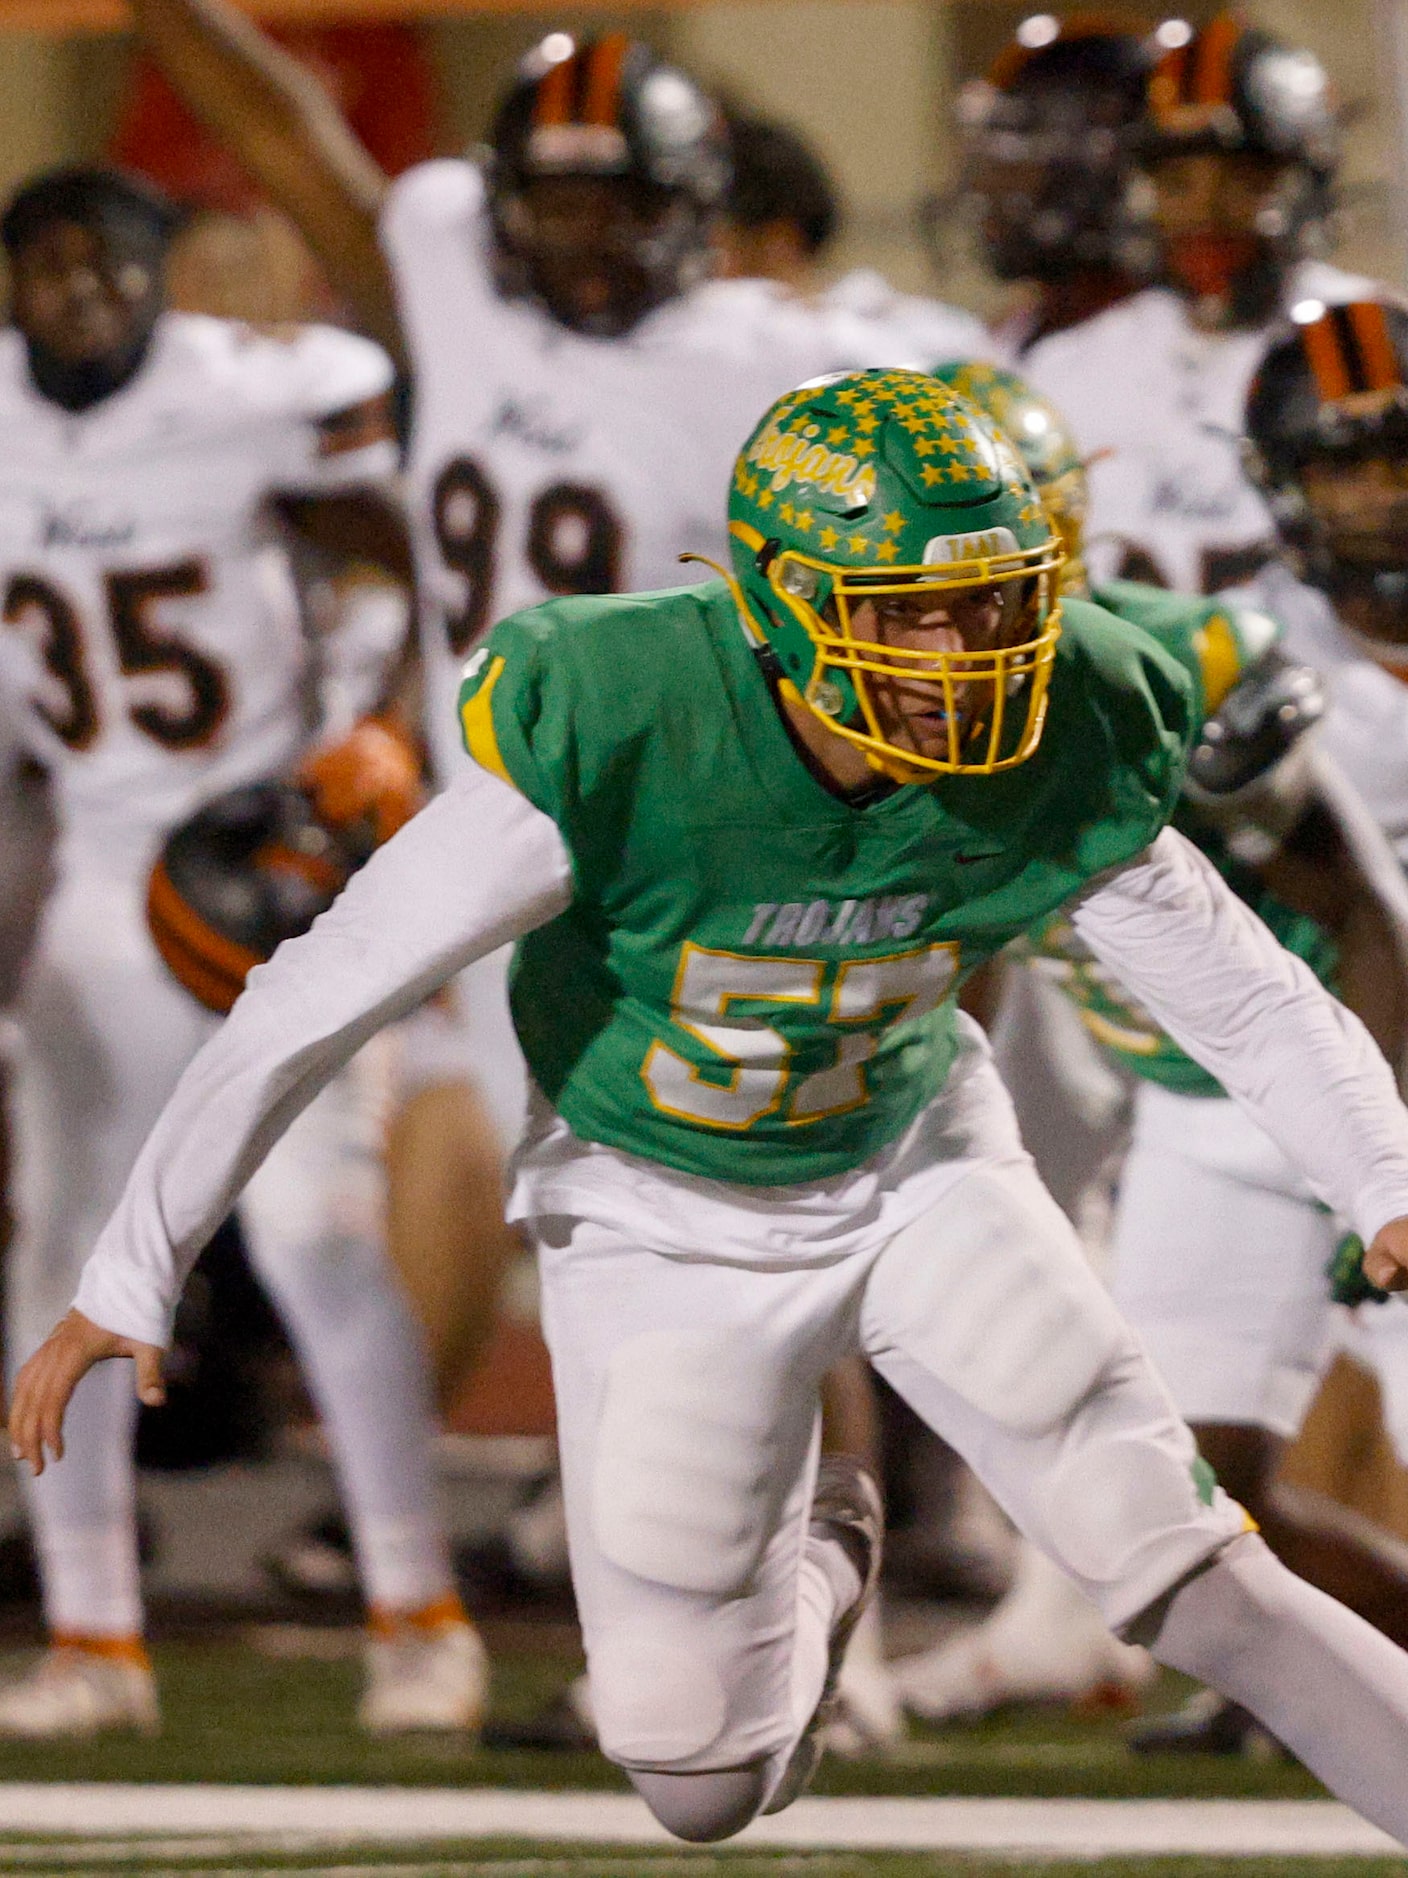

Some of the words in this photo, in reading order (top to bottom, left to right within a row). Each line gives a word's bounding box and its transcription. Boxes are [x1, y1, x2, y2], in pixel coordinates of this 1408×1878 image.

[2, 556, 230, 752] 35
[742, 895, 930, 947] TROJANS
[640, 939, 961, 1132] 57
